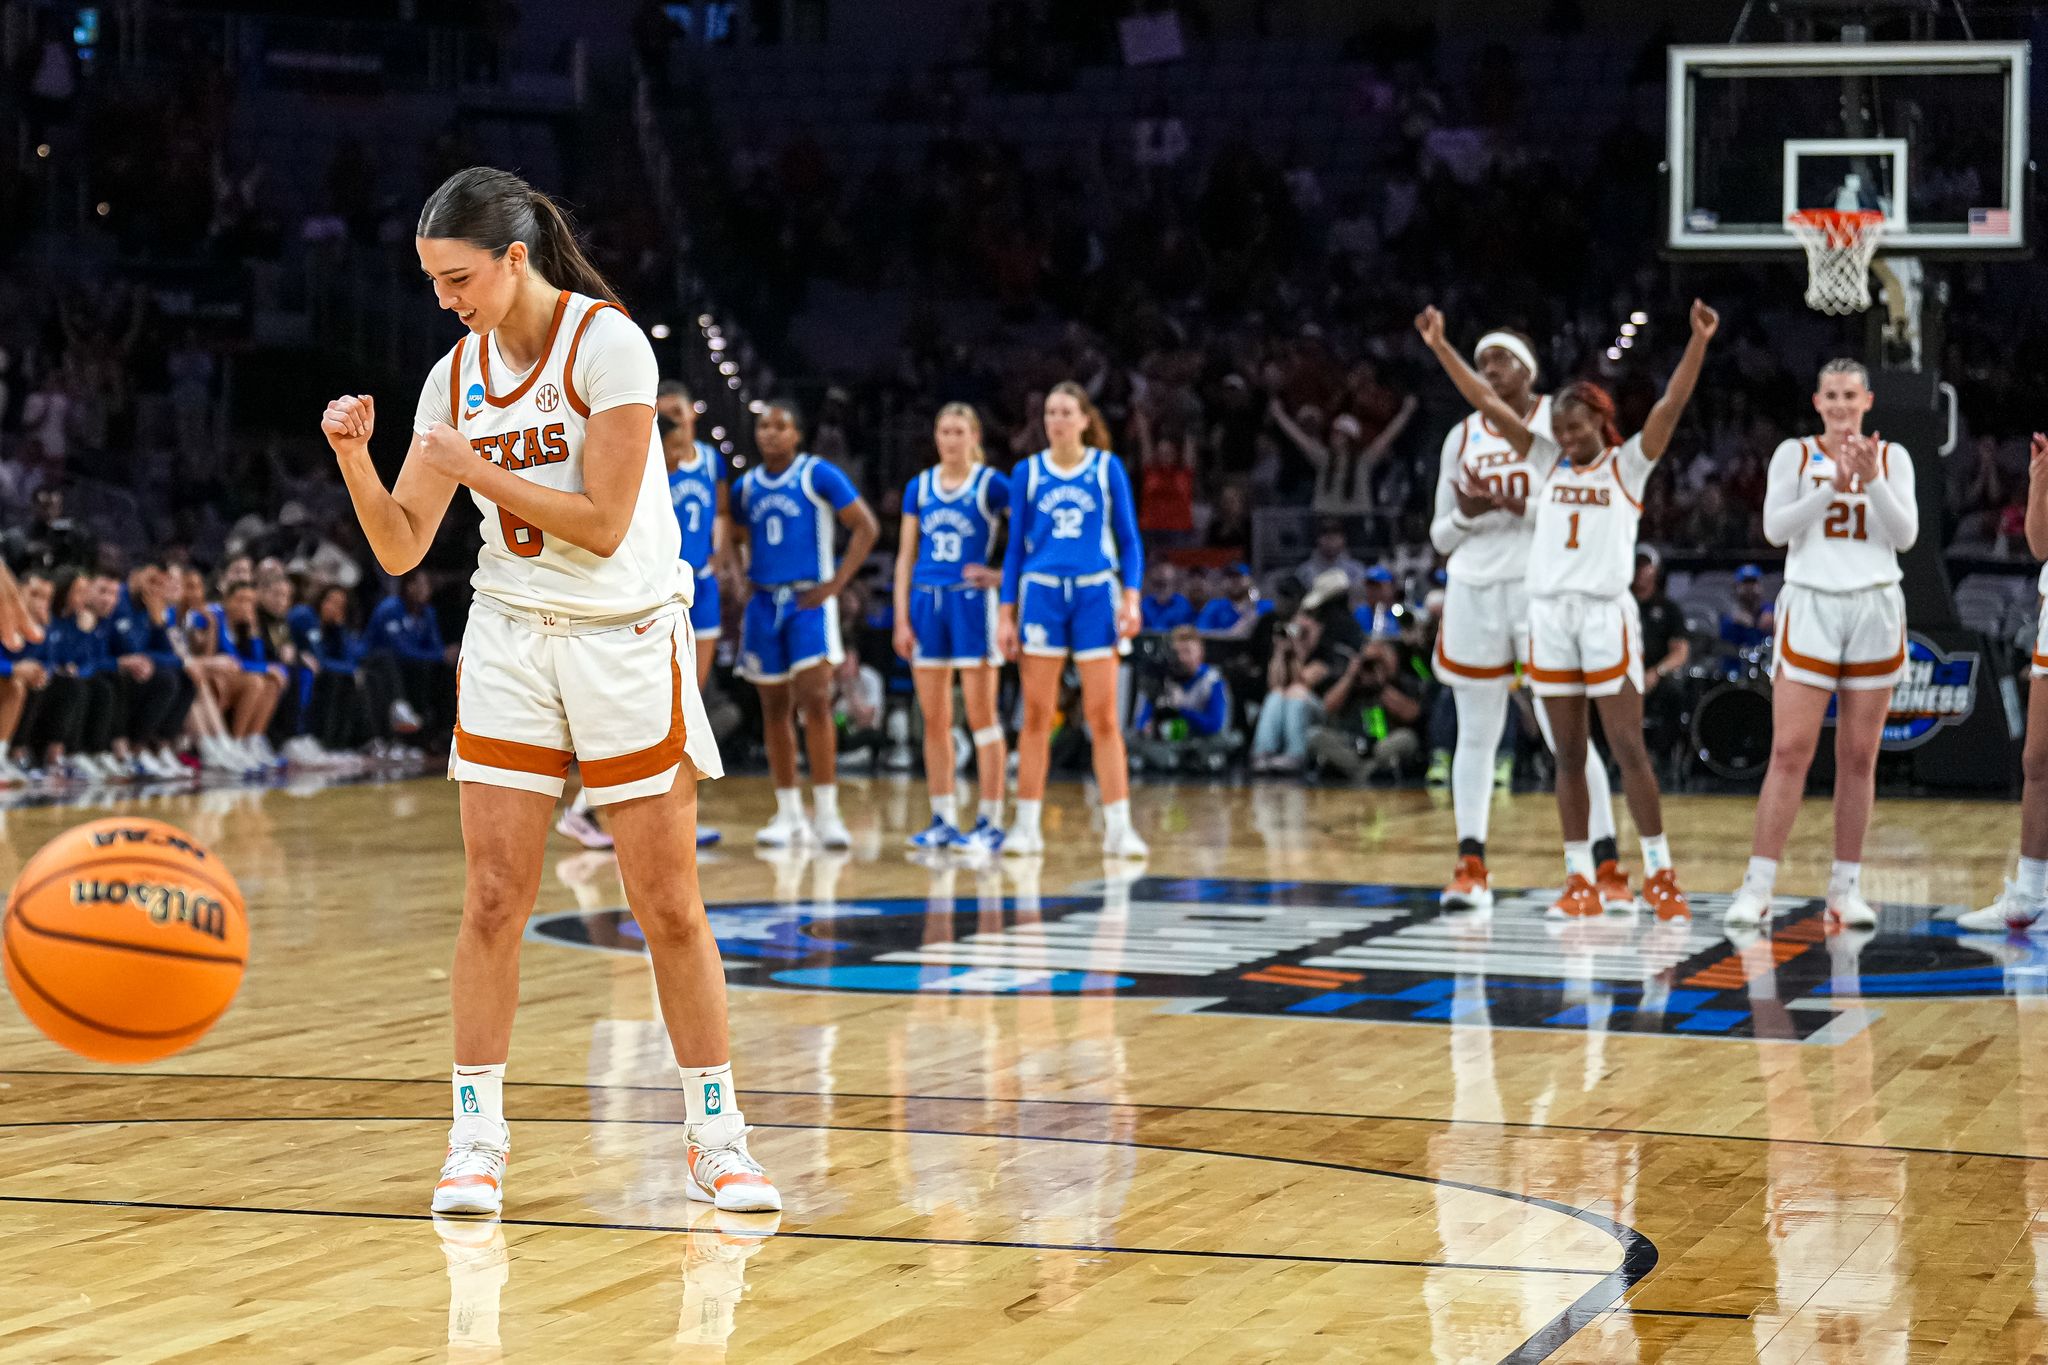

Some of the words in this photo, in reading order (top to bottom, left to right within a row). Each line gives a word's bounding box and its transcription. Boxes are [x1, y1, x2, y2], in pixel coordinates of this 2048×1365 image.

[538, 385, 559, 411] SEC
[1552, 485, 1610, 507] TEXAS
[684, 501, 700, 533] 7
[766, 515, 784, 546] 0
[1051, 506, 1084, 540] 32
[1565, 511, 1579, 549] 1
[1825, 501, 1867, 540] 21
[930, 530, 963, 563] 33
[72, 878, 226, 941] Wilson
